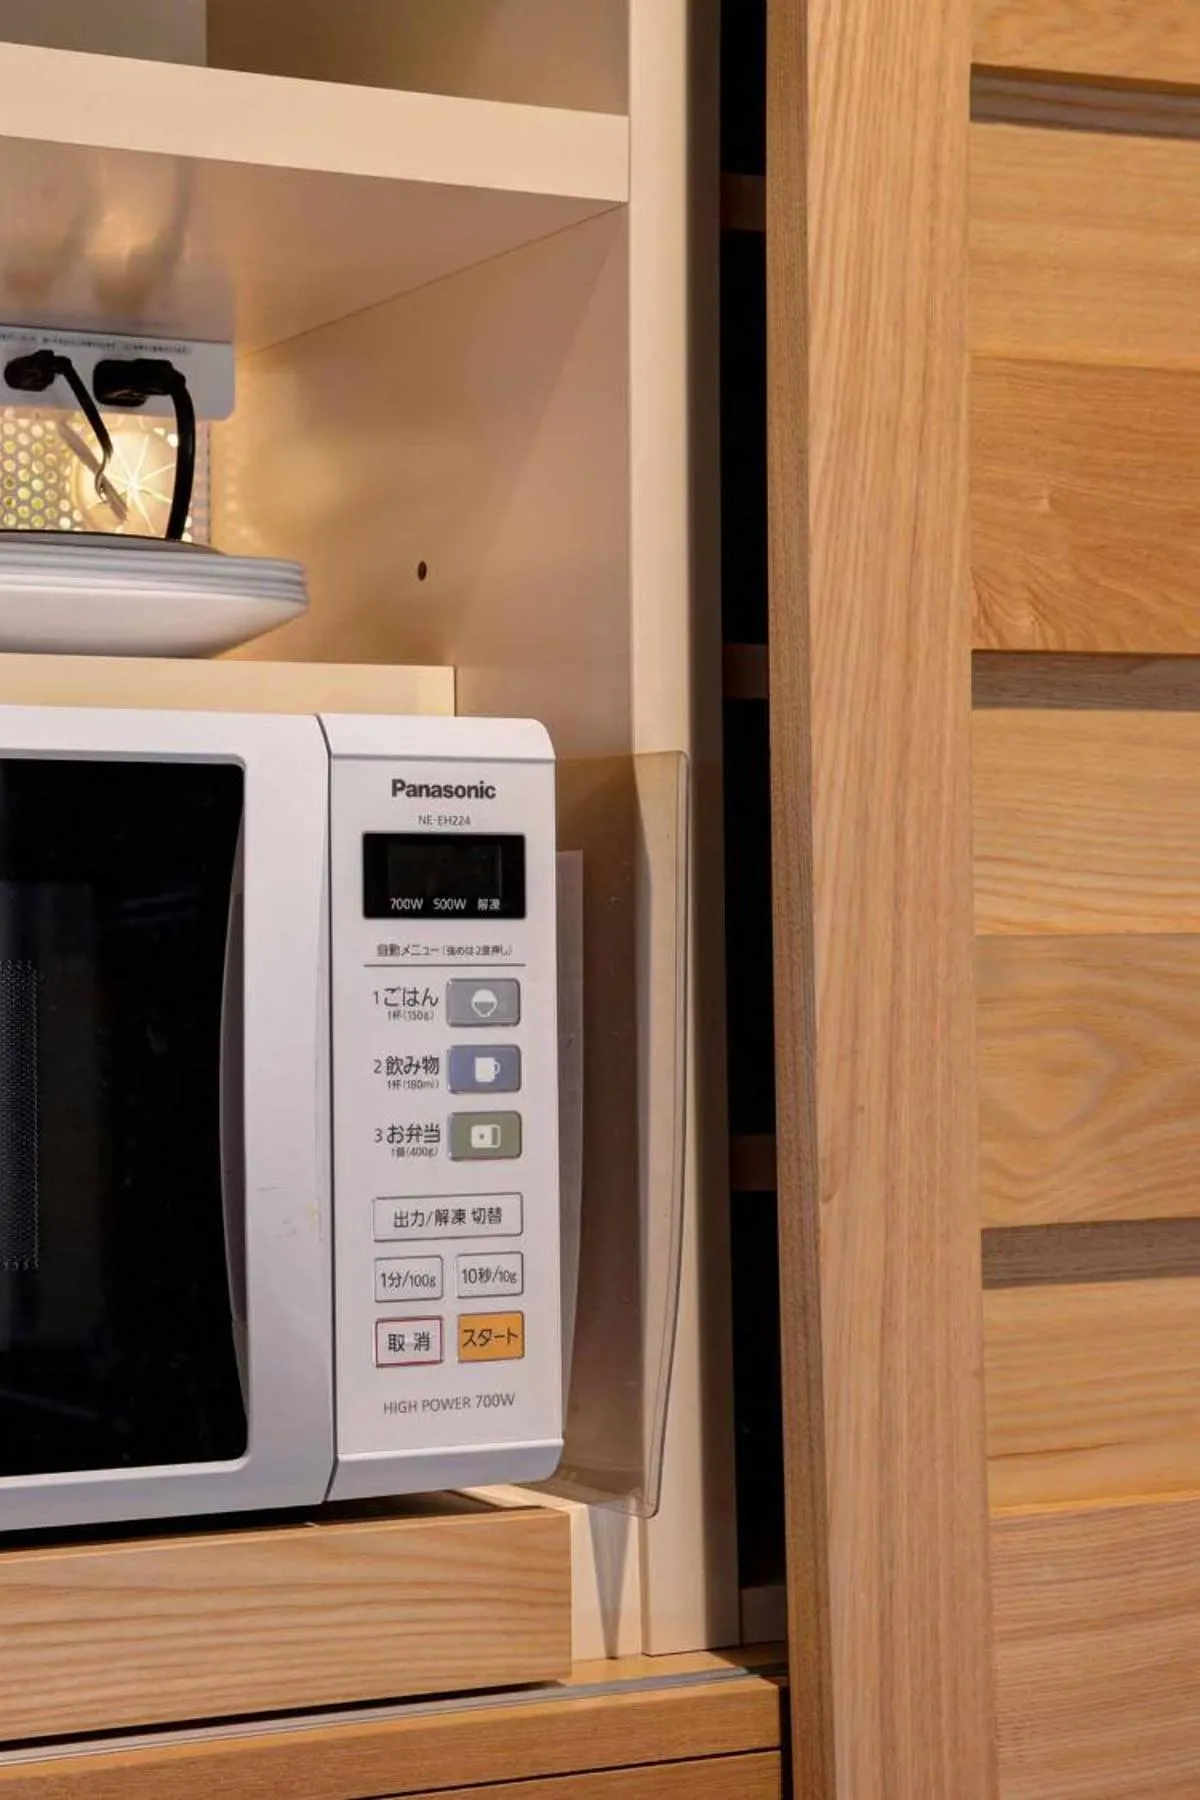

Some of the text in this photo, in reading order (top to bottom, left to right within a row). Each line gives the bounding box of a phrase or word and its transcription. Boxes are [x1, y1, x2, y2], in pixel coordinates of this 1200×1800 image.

[391, 779, 497, 799] Panasonic
[418, 815, 471, 826] NE-EH224
[391, 898, 424, 910] 700W
[433, 898, 467, 910] 500W
[384, 986, 439, 1007] ごはん
[385, 1056, 440, 1076] 飲み物
[386, 1123, 441, 1145] お弁当
[380, 1271, 437, 1289] 1分/100g
[462, 1268, 518, 1286] 10秒/10g
[462, 1328, 519, 1348] スタート
[383, 1393, 516, 1415] HIGH POWER 700W
